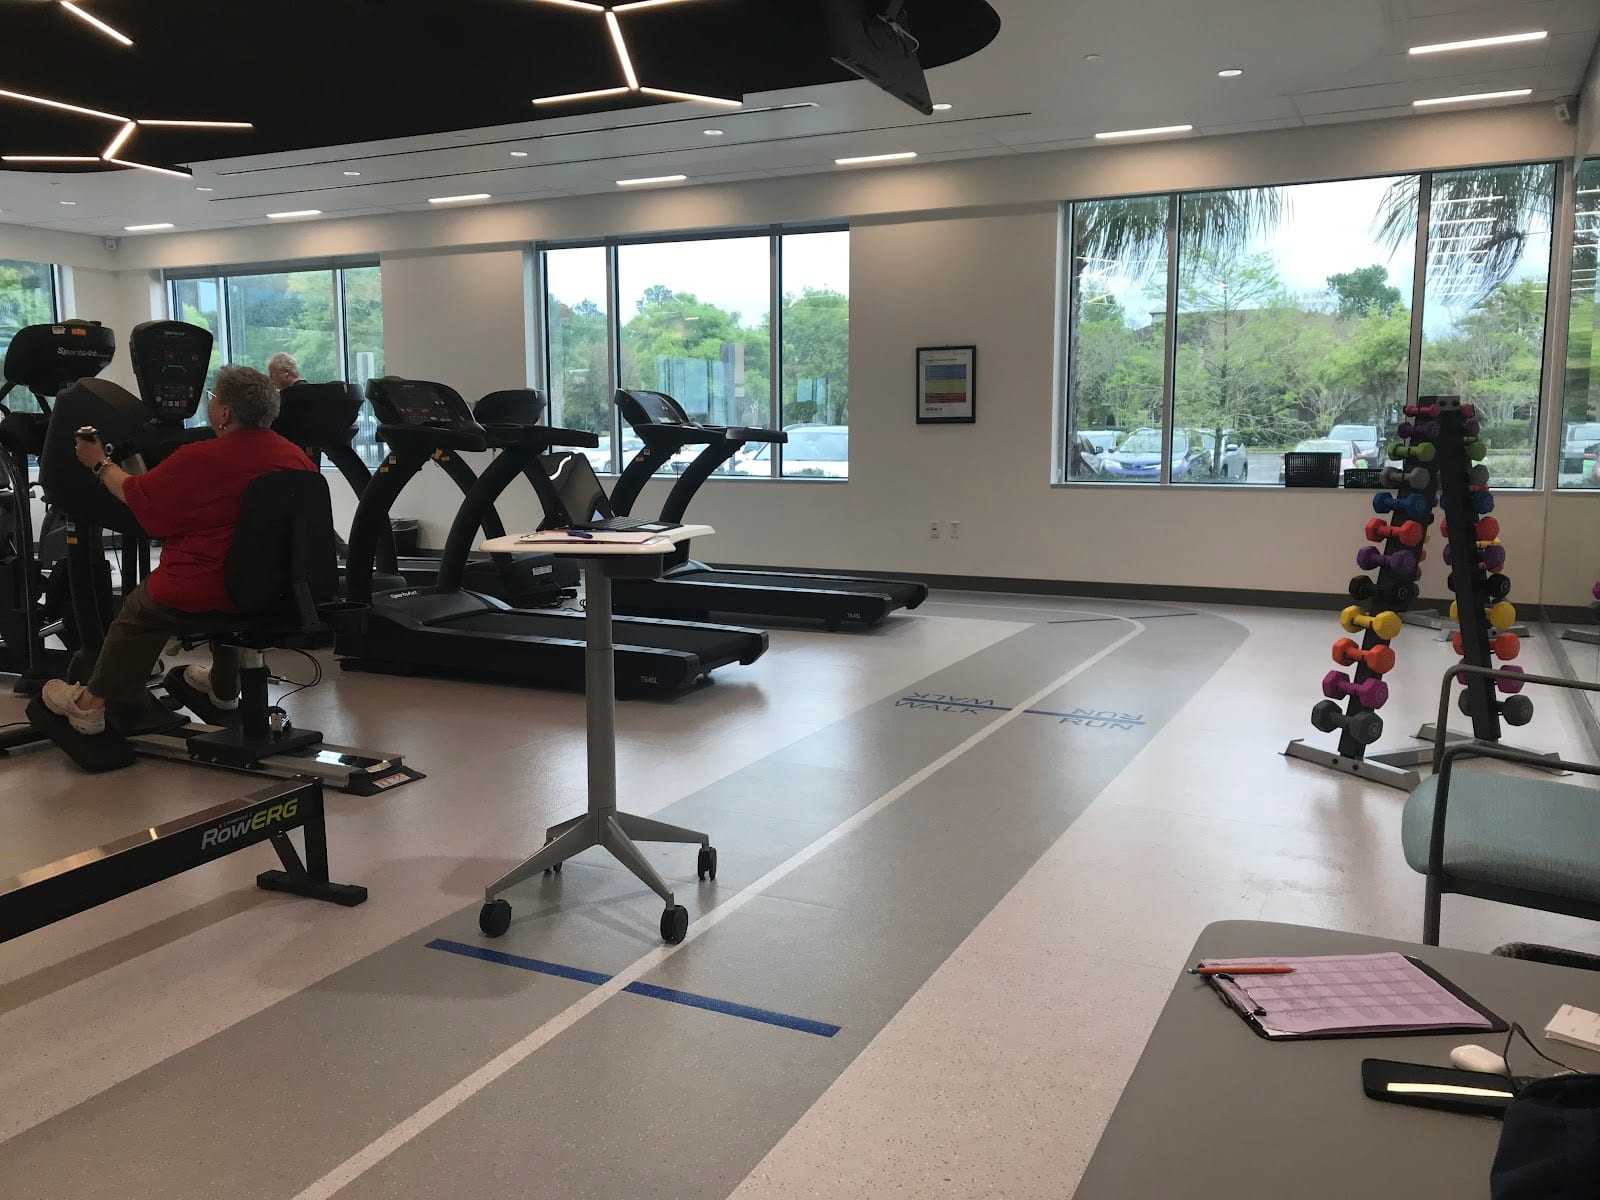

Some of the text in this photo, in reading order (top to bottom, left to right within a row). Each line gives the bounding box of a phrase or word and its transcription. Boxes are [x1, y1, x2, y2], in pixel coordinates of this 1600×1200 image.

[57, 346, 97, 357] SportsArt
[907, 692, 994, 706] WALK
[895, 701, 985, 715] WALK
[1072, 708, 1144, 721] RUN
[1059, 717, 1135, 731] RUN
